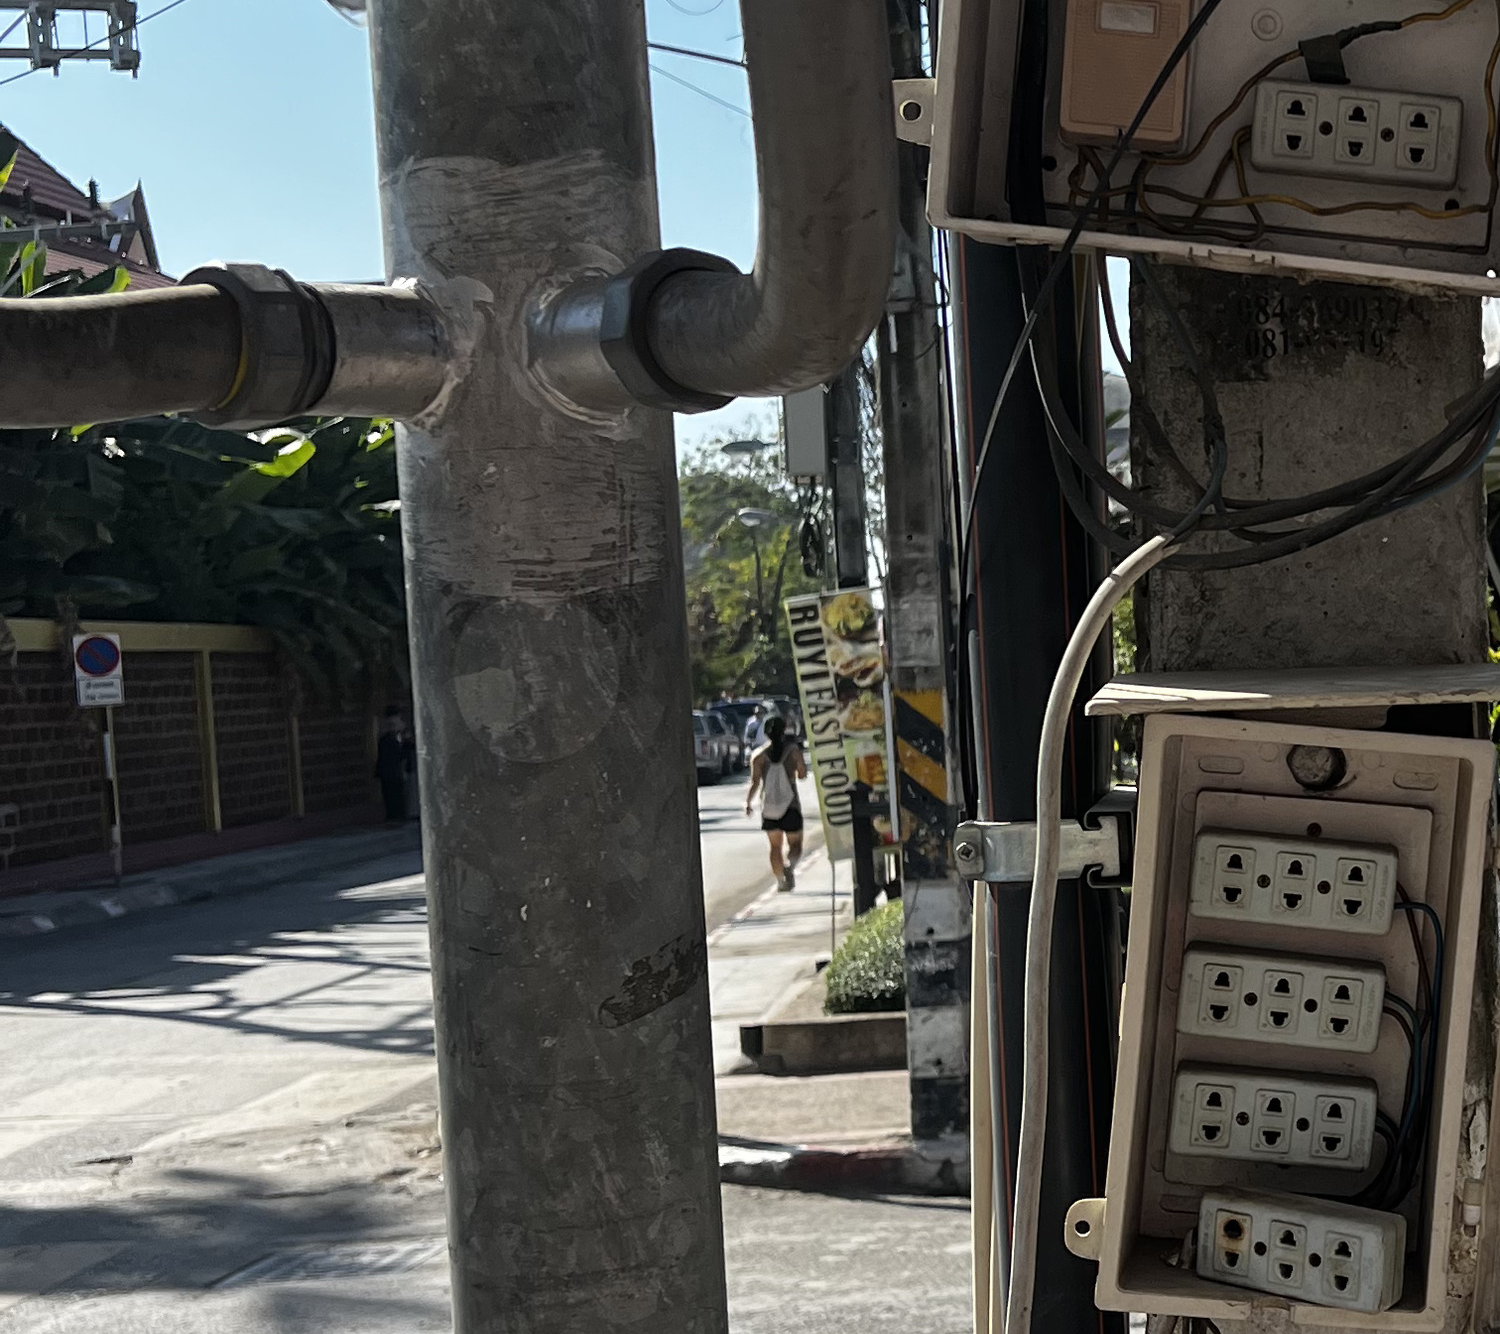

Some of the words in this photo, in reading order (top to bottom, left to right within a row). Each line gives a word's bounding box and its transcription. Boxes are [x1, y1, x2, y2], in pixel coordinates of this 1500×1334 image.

[789, 604, 831, 682] RUYI
[805, 687, 843, 750] FAST
[817, 754, 853, 827] FOOD
